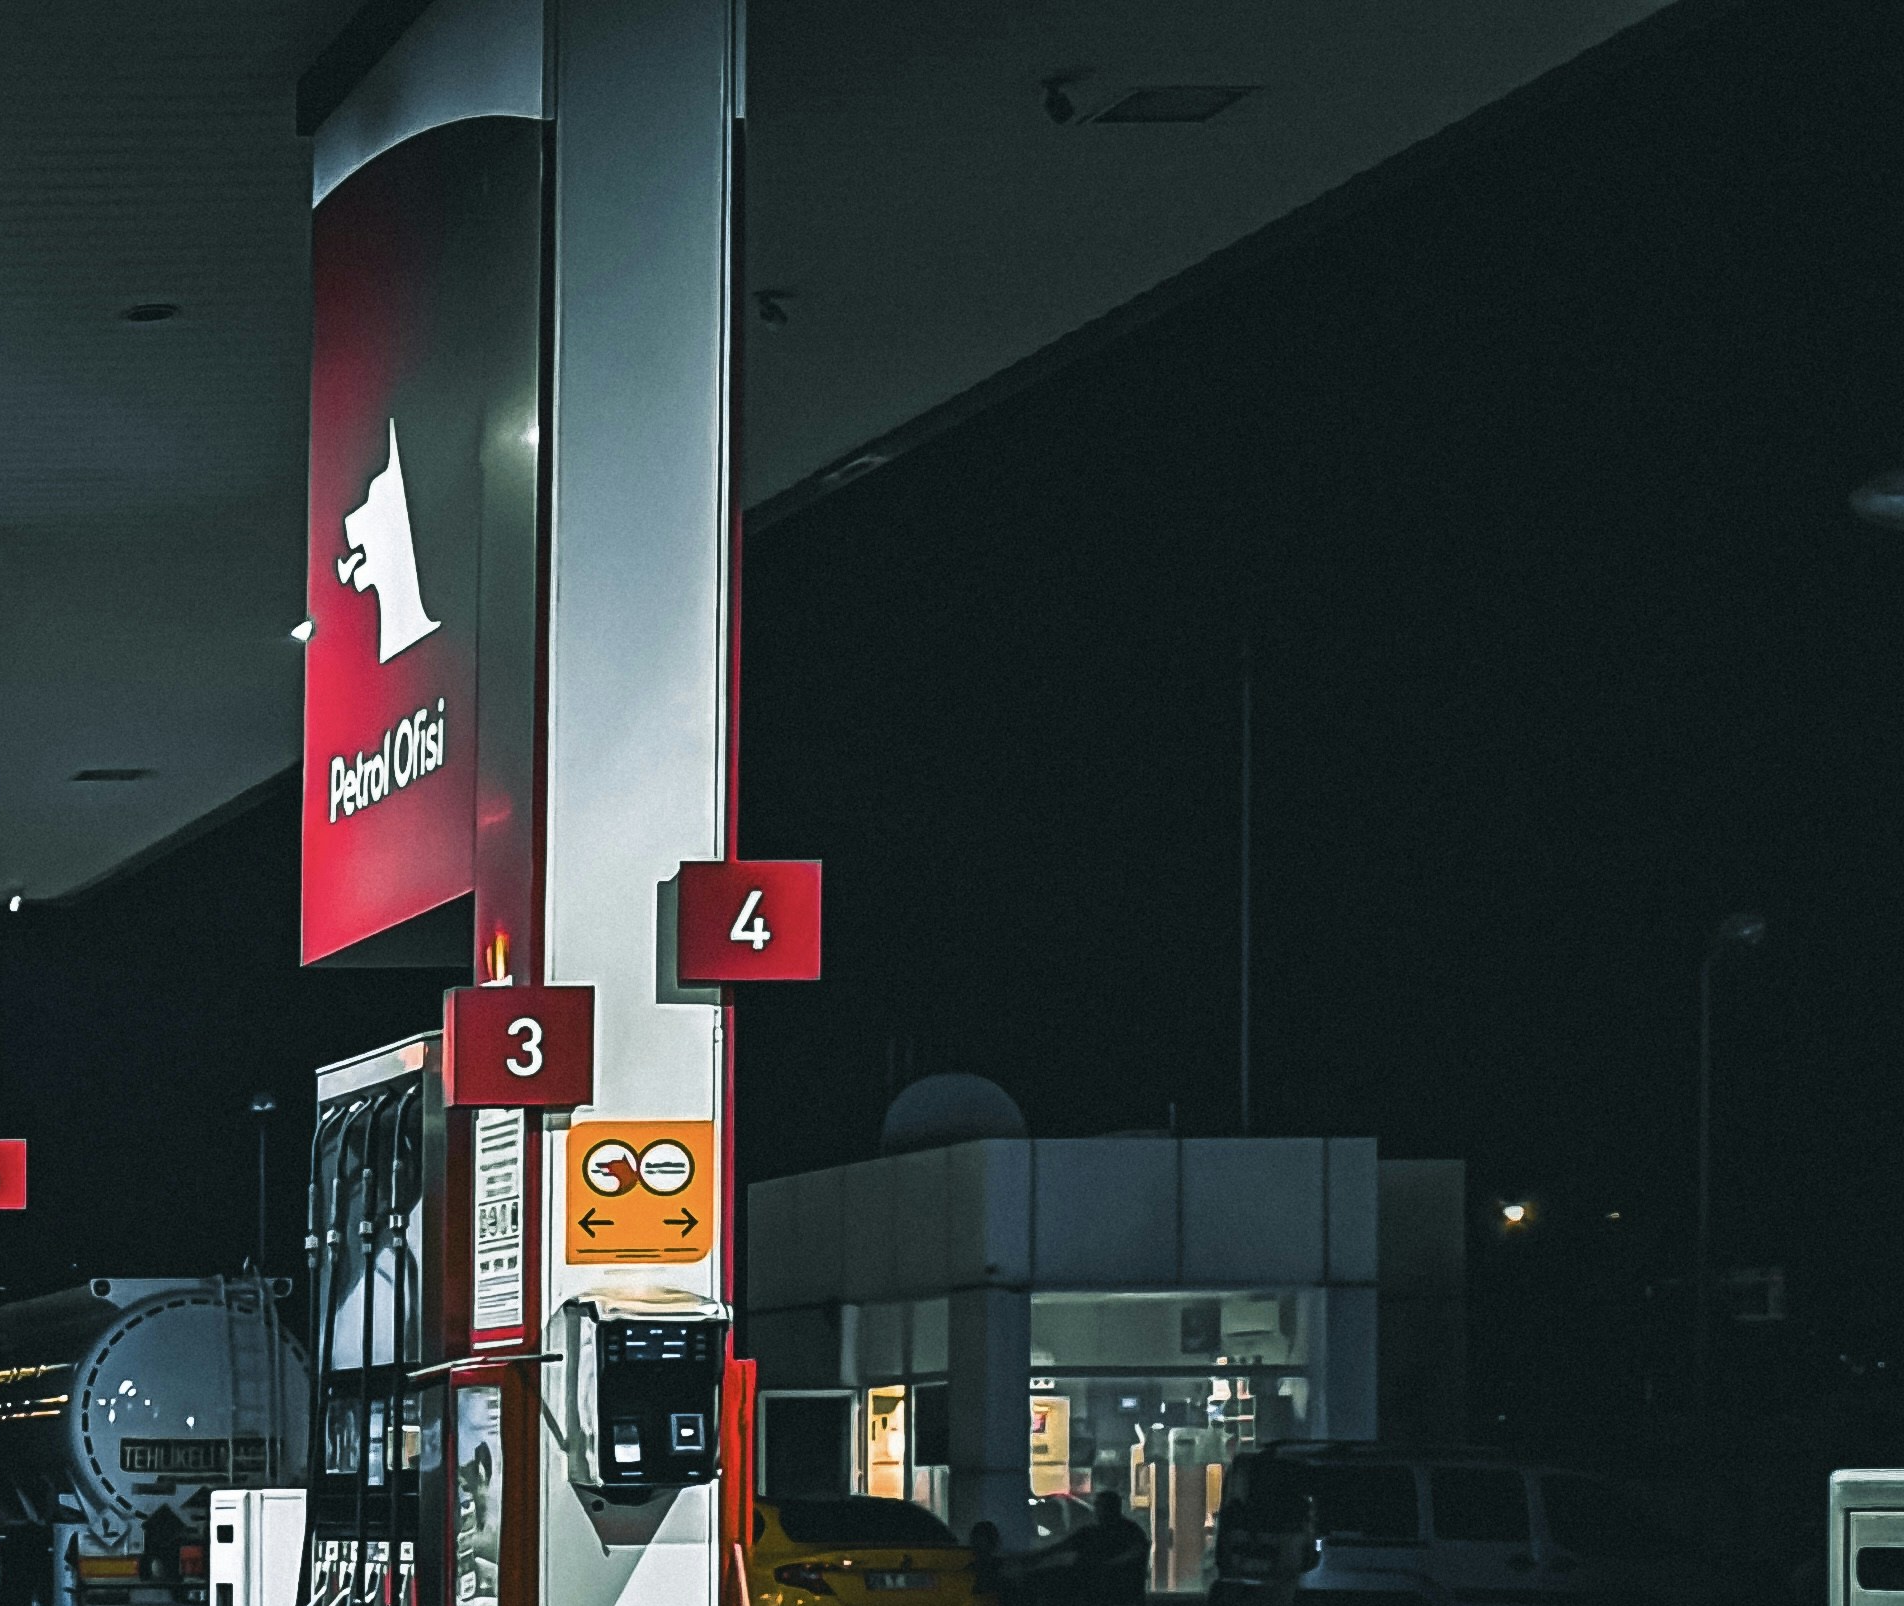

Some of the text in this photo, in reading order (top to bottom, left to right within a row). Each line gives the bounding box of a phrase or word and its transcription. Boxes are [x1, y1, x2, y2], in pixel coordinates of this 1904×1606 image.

[329, 697, 445, 824] Petrol Ofisi
[730, 891, 771, 950] 4
[506, 1017, 543, 1077] 3
